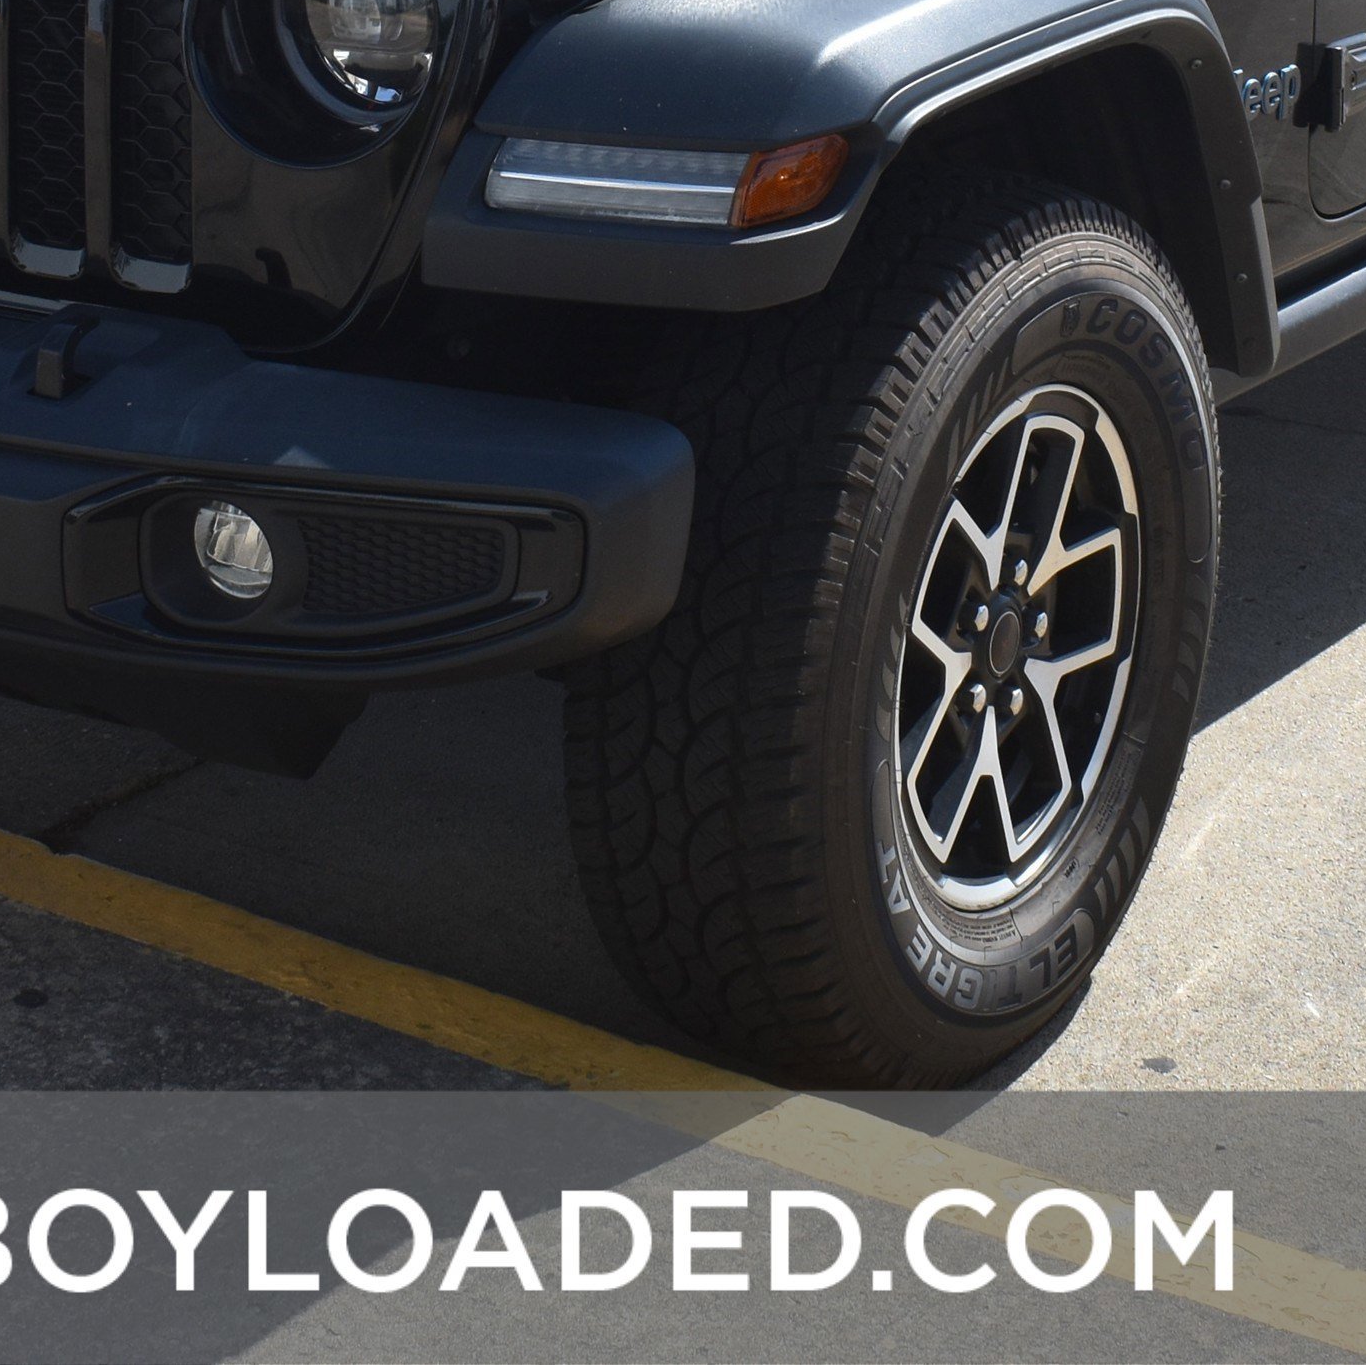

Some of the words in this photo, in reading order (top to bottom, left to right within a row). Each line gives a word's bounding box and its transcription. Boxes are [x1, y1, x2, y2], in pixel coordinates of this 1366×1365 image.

[1086, 298, 1206, 472] COSMO
[875, 840, 910, 916] AT
[905, 923, 1023, 1012] TIGRE
[1029, 920, 1080, 991] EL
